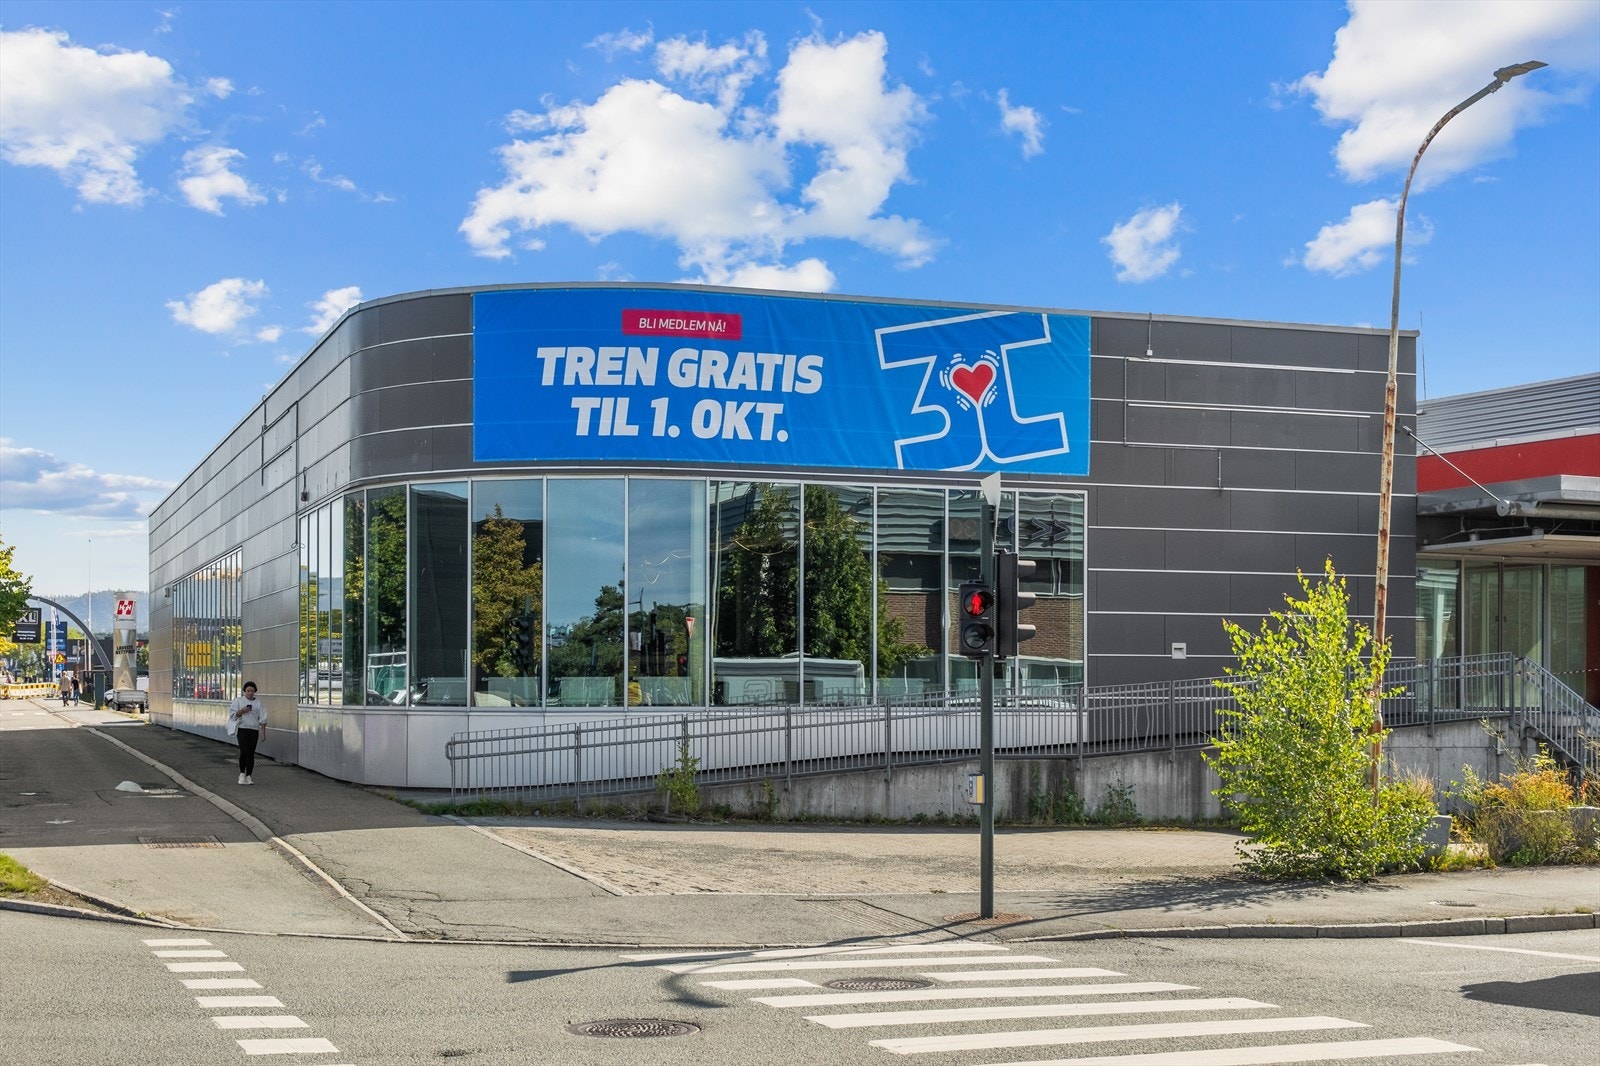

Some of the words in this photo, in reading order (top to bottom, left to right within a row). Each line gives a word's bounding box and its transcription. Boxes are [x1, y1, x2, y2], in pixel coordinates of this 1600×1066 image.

[638, 317, 656, 329] BLI
[658, 318, 706, 331] MEDLEM
[707, 319, 726, 332] NÅ!
[536, 346, 660, 386] TREN
[667, 348, 824, 394] GRATIS
[571, 397, 639, 436] TIL
[650, 397, 680, 438] 1.
[691, 399, 788, 442] OKT.
